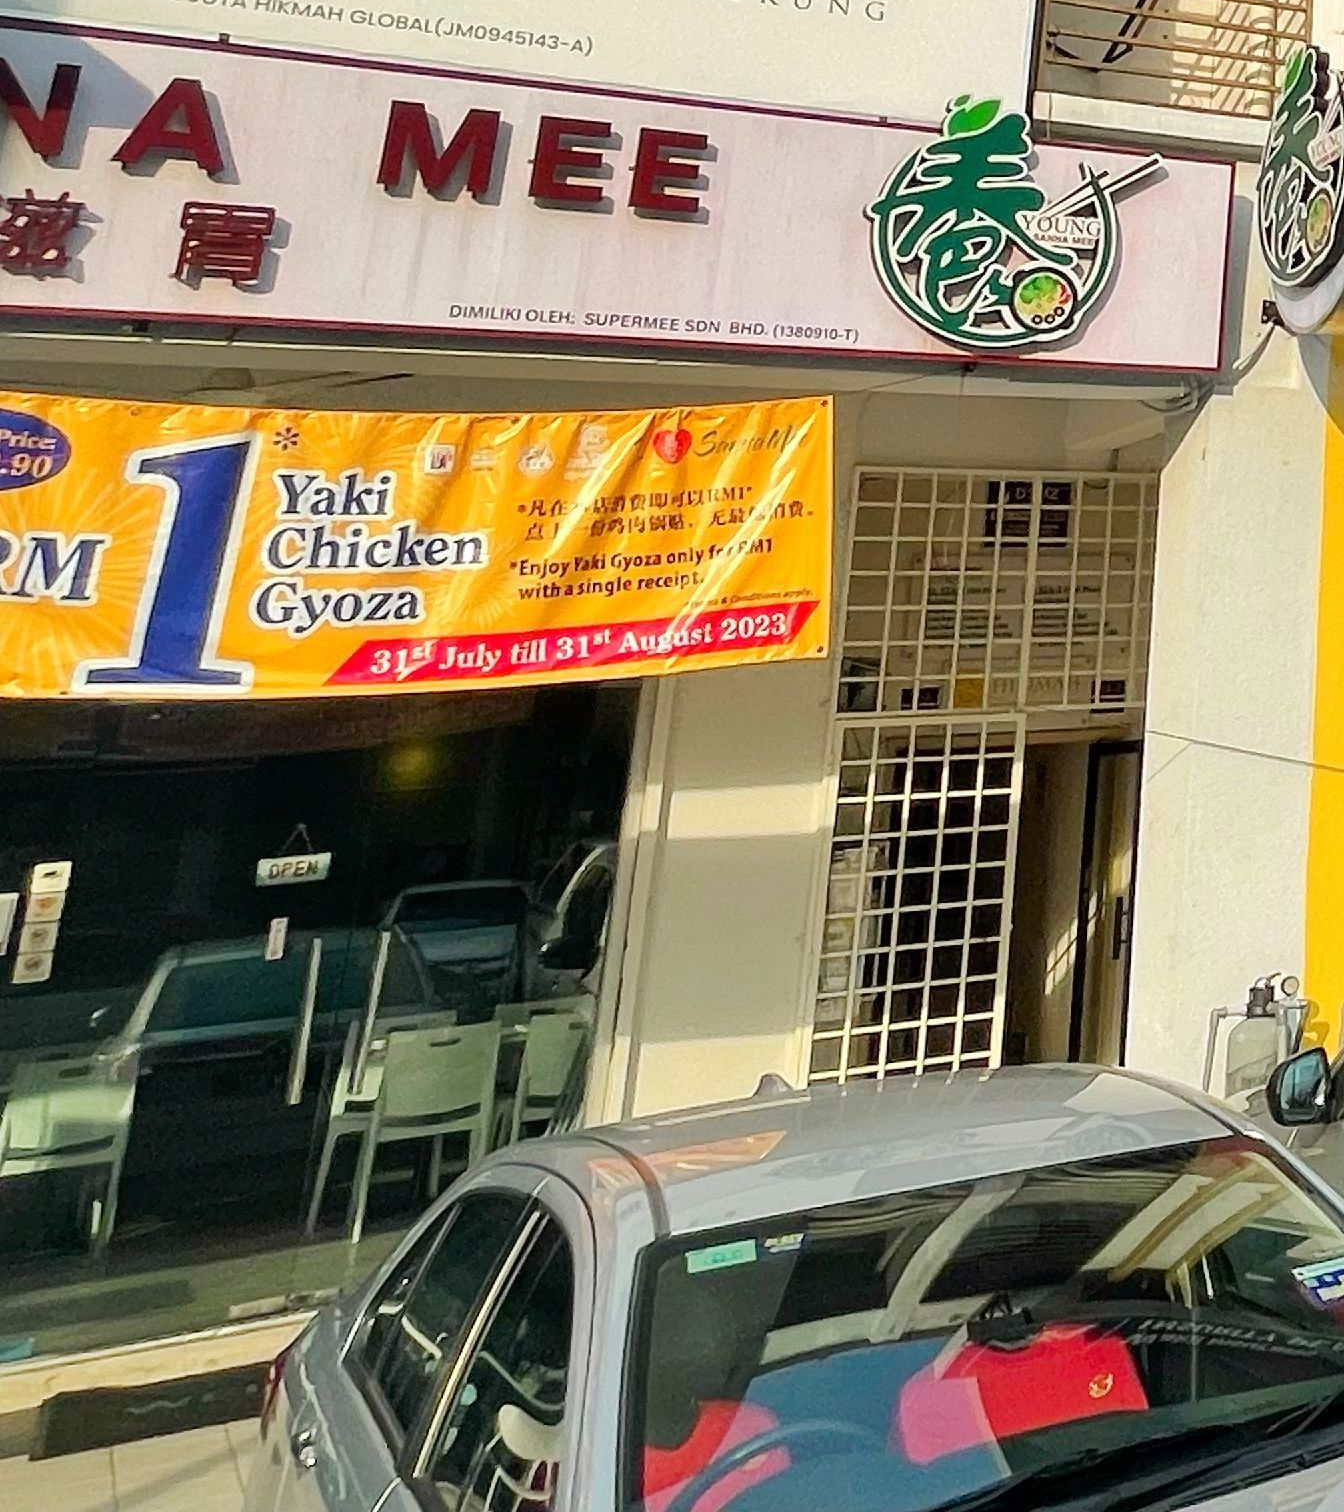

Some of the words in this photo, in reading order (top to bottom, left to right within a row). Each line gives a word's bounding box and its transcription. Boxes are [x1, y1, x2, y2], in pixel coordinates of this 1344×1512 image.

[377, 100, 708, 213] MEE
[1023, 214, 1100, 238] YOUNG
[449, 305, 521, 321] DIMILIKI
[525, 309, 575, 324] OLEH:
[584, 312, 680, 332] SUPERMEE
[685, 319, 720, 334] SDN
[729, 321, 768, 337] BHD.
[277, 474, 391, 516] Yaki
[86, 439, 253, 684] 1
[267, 525, 484, 570] Chicken
[573, 555, 606, 572] Yaki
[610, 552, 662, 572] Gyoza
[666, 548, 706, 568] only
[255, 582, 419, 633] Gyoza
[518, 582, 561, 600] with
[564, 586, 574, 596] a
[578, 578, 632, 600] single
[370, 639, 437, 675] 31st
[439, 641, 501, 670] July
[510, 637, 547, 663] till
[556, 629, 611, 661] 31st
[619, 621, 712, 656] August
[721, 613, 788, 642] 2023
[268, 858, 321, 880] OPEN
